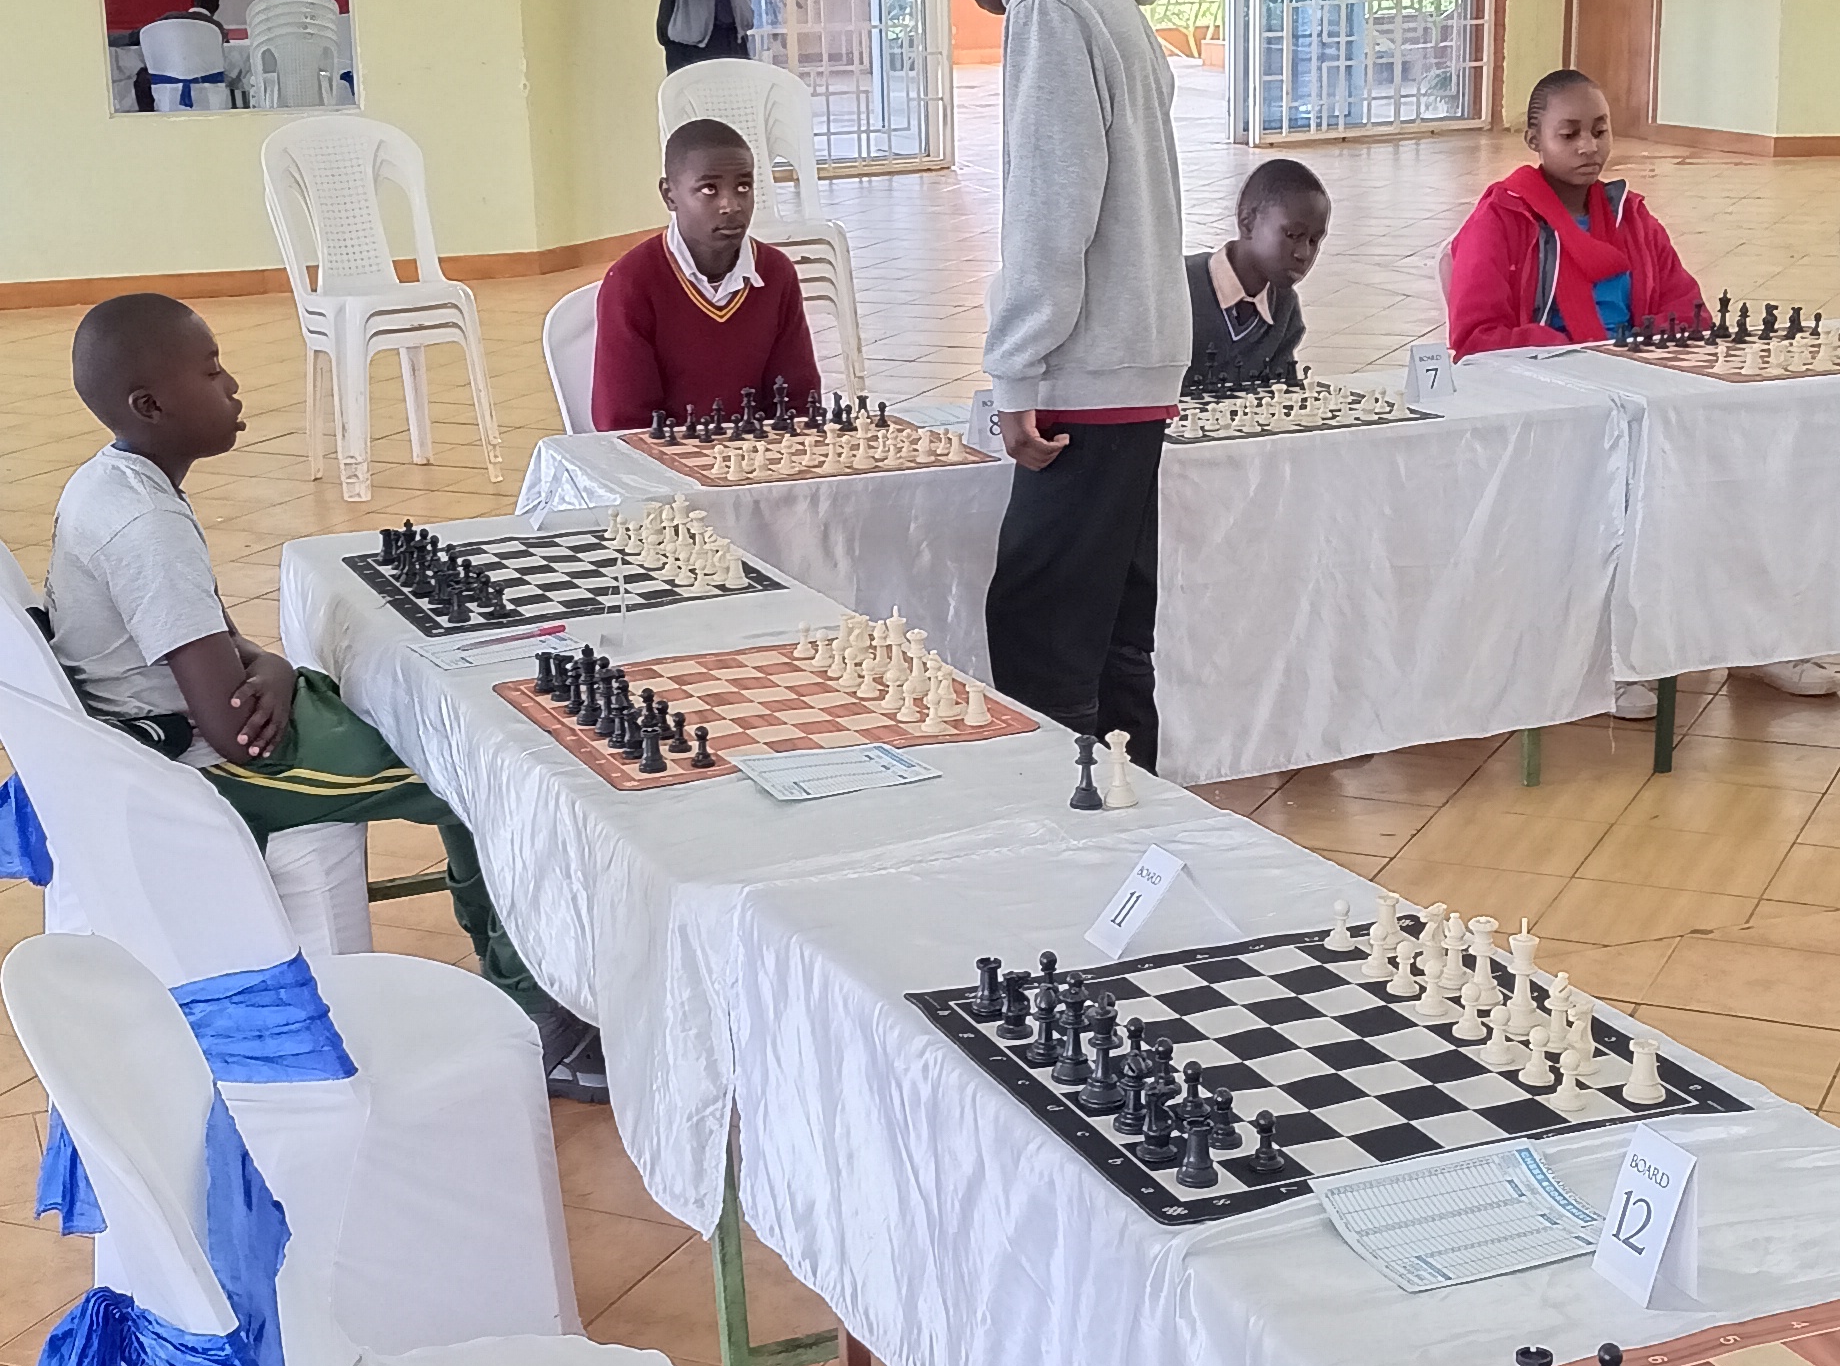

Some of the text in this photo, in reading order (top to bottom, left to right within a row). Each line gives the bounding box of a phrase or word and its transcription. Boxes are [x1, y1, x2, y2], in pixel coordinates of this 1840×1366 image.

[1425, 367, 1439, 390] 7
[989, 413, 1002, 436] 8
[1110, 890, 1143, 928] 11
[1630, 1154, 1670, 1188] BOARD
[1612, 1190, 1652, 1255] 12
